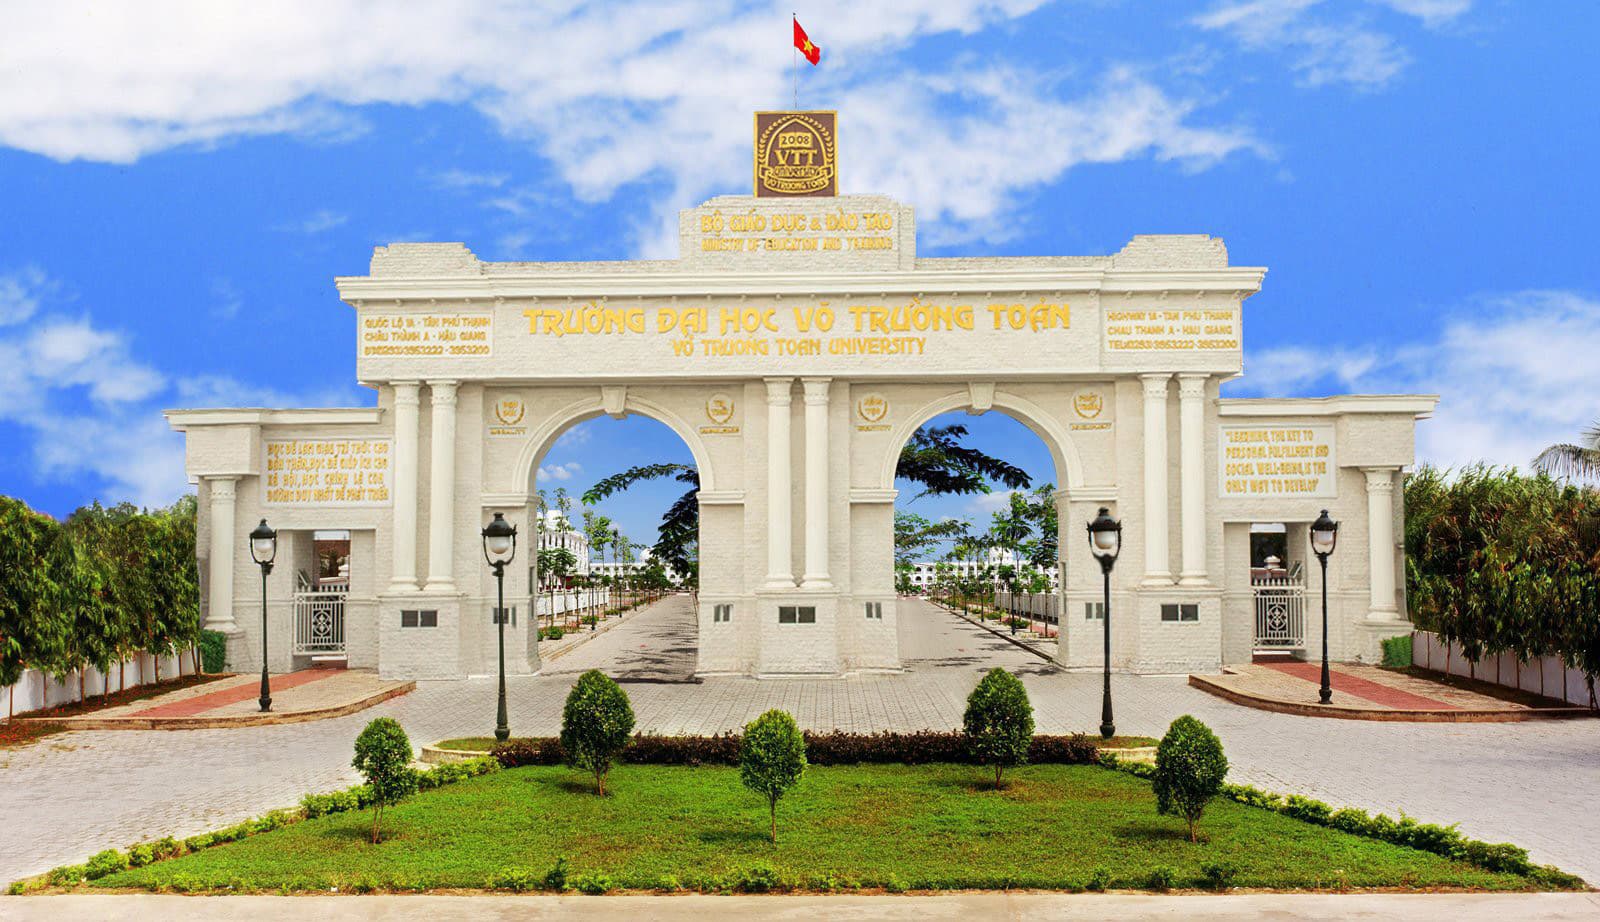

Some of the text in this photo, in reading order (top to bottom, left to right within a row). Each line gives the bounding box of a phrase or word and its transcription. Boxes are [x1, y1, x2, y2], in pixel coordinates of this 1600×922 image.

[781, 135, 810, 145] 2008
[774, 149, 818, 165] VTT
[701, 210, 724, 236] BỘ
[729, 208, 767, 232] GIÁO
[810, 218, 821, 231] &
[825, 208, 859, 231] ĐÀO
[863, 213, 893, 235] TẠO
[701, 237, 893, 251] MINISTRY OF EDUCATION AND TRAINING
[523, 300, 646, 337] TRƯỜNG
[656, 307, 709, 339] ĐẠI
[719, 307, 779, 338] HỌC
[793, 301, 835, 333] VÕ
[848, 296, 975, 335] TRƯỜNG
[828, 337, 926, 355] UNIVERSITY
[1303, 430, 1314, 441] TO
